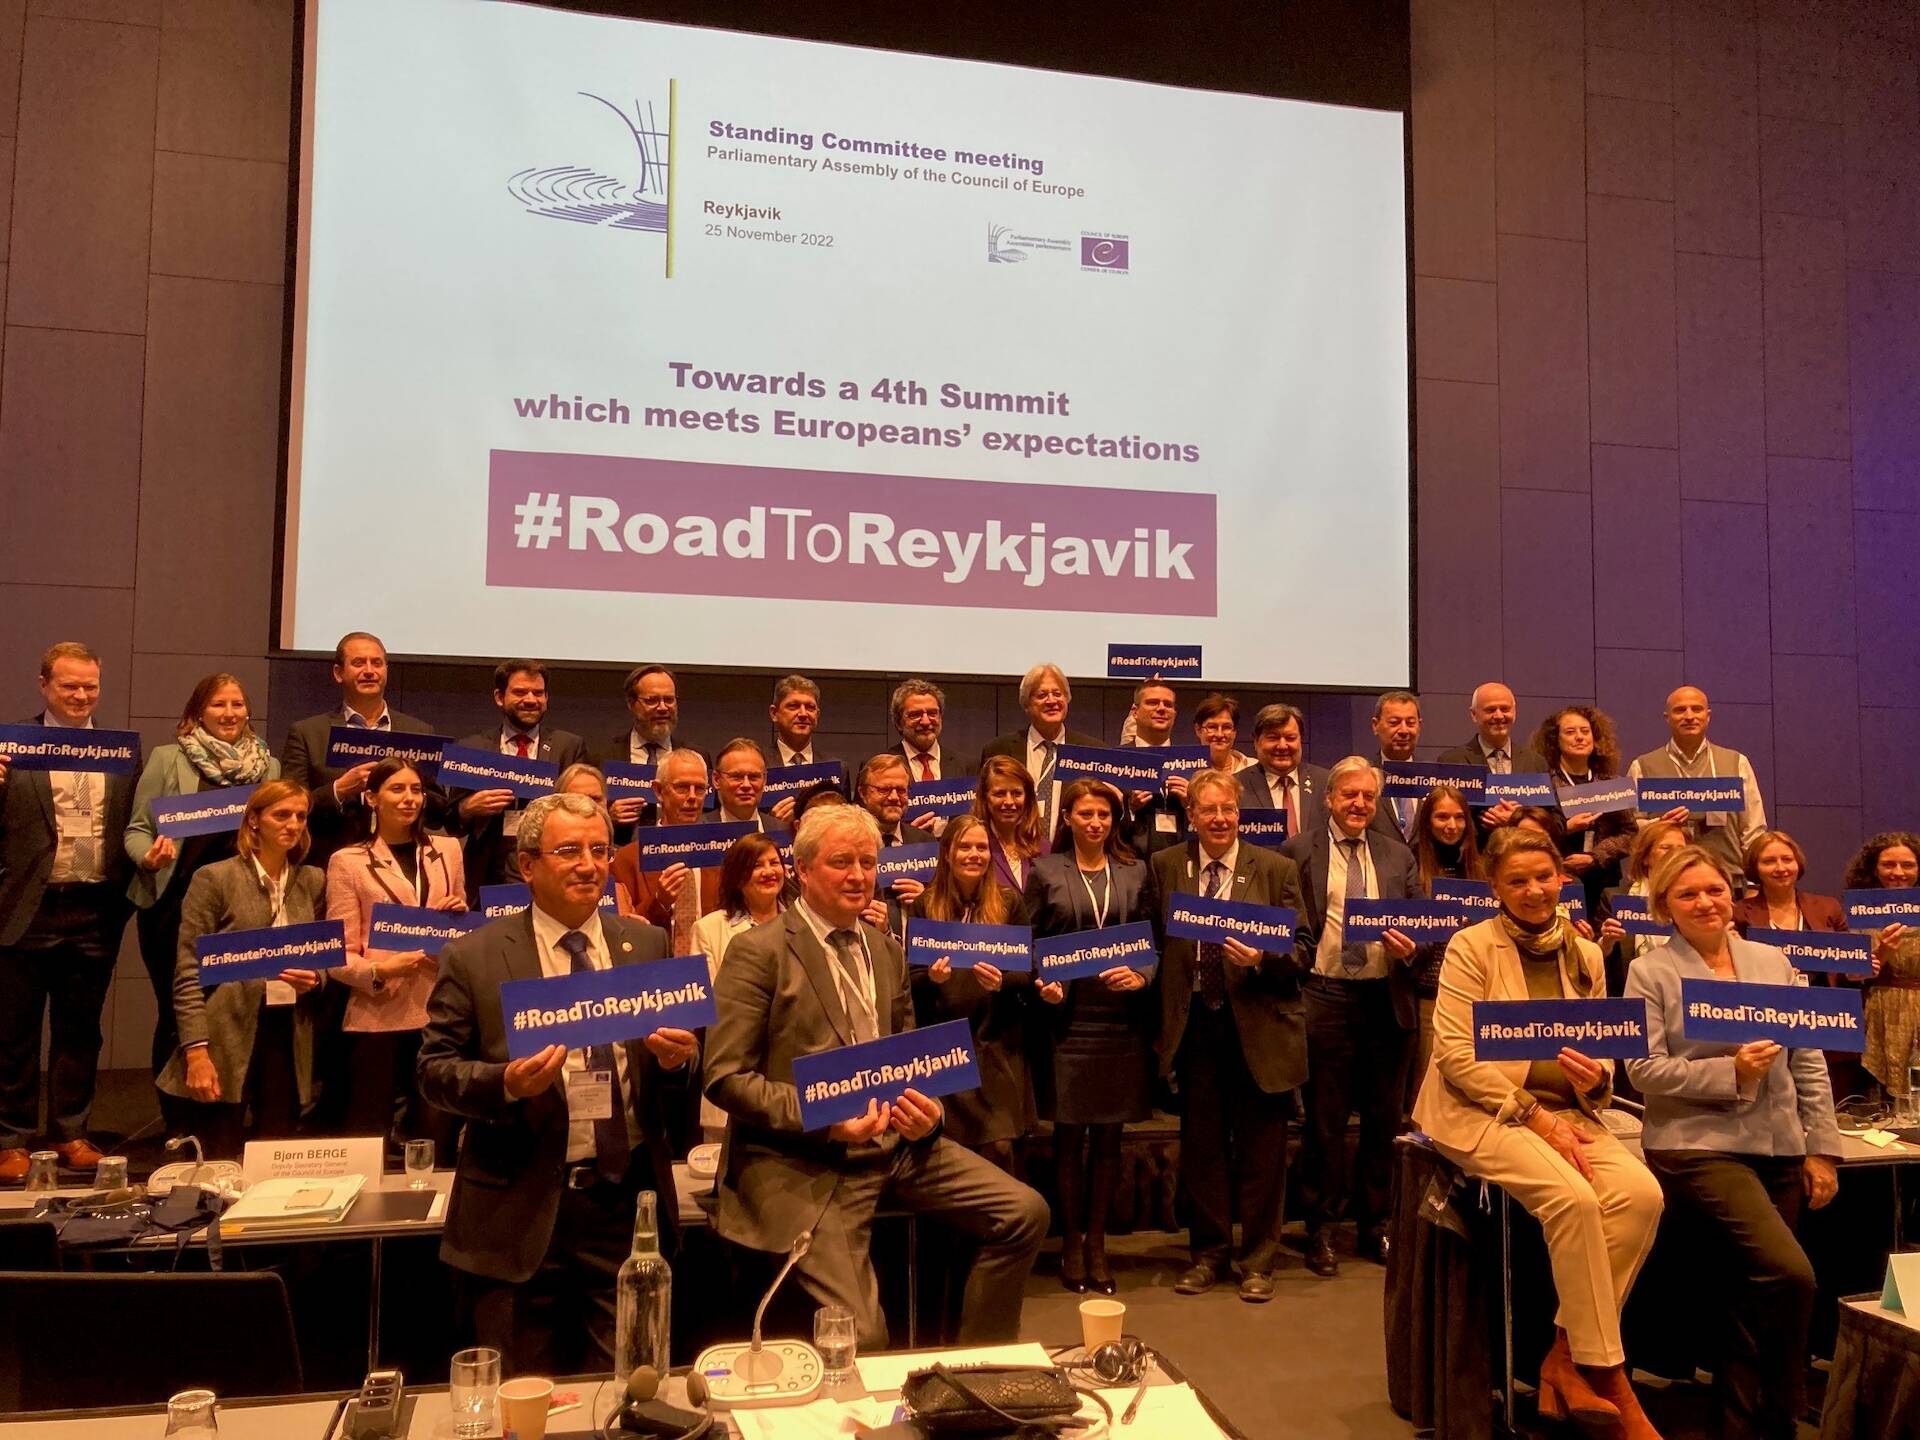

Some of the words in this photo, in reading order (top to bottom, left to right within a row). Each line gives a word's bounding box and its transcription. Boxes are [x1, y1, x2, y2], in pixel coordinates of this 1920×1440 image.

[709, 120, 814, 150] Standing
[822, 133, 947, 161] Committee
[954, 150, 1044, 176] meeting
[707, 146, 818, 172] Parliamentary
[822, 158, 899, 180] Assembly
[903, 168, 919, 179] of
[923, 169, 947, 182] the
[951, 172, 1008, 189] Council
[1013, 179, 1028, 191] of
[1032, 181, 1085, 199] Europe
[703, 200, 781, 220] Reykjavik
[704, 223, 722, 237] 25
[727, 225, 797, 244] November
[801, 233, 834, 248] 2022
[669, 362, 826, 398] Towards
[839, 380, 859, 401] a
[871, 378, 928, 406] 4th
[939, 383, 1070, 416] Summit
[514, 393, 630, 425] which
[644, 407, 761, 434] meets
[982, 430, 1200, 463] expectations
[514, 491, 1195, 587] #RoadToReykjavik
[1111, 656, 1199, 668] #RoadToReykjavik
[0, 741, 132, 759] #RoadToReykjavik
[442, 760, 554, 788] #EnRoutePourReykjavik
[1059, 759, 1158, 779] #RoadToReykjavik
[1641, 789, 1741, 803] #RoadToReykjavik
[158, 804, 249, 825] #EnRoutePourRey
[1172, 909, 1291, 938] #RoadToReykjavik
[1348, 914, 1459, 929] #RoadToReykjavik
[201, 938, 343, 968] #EnRoutePourReykjavik
[912, 935, 1029, 955] #EnRoutePourReykjavik
[1041, 938, 1152, 967] #RoadToReykjavik
[513, 981, 708, 1031] #RoadToReykjavik
[1689, 1003, 1858, 1031] #RoadToReykjavik
[1479, 1021, 1642, 1042] #RoadToReykjavik
[804, 1047, 971, 1103] #RoadToReykjavik
[273, 1151, 304, 1162] Bjørn
[307, 1149, 348, 1159] BERGE
